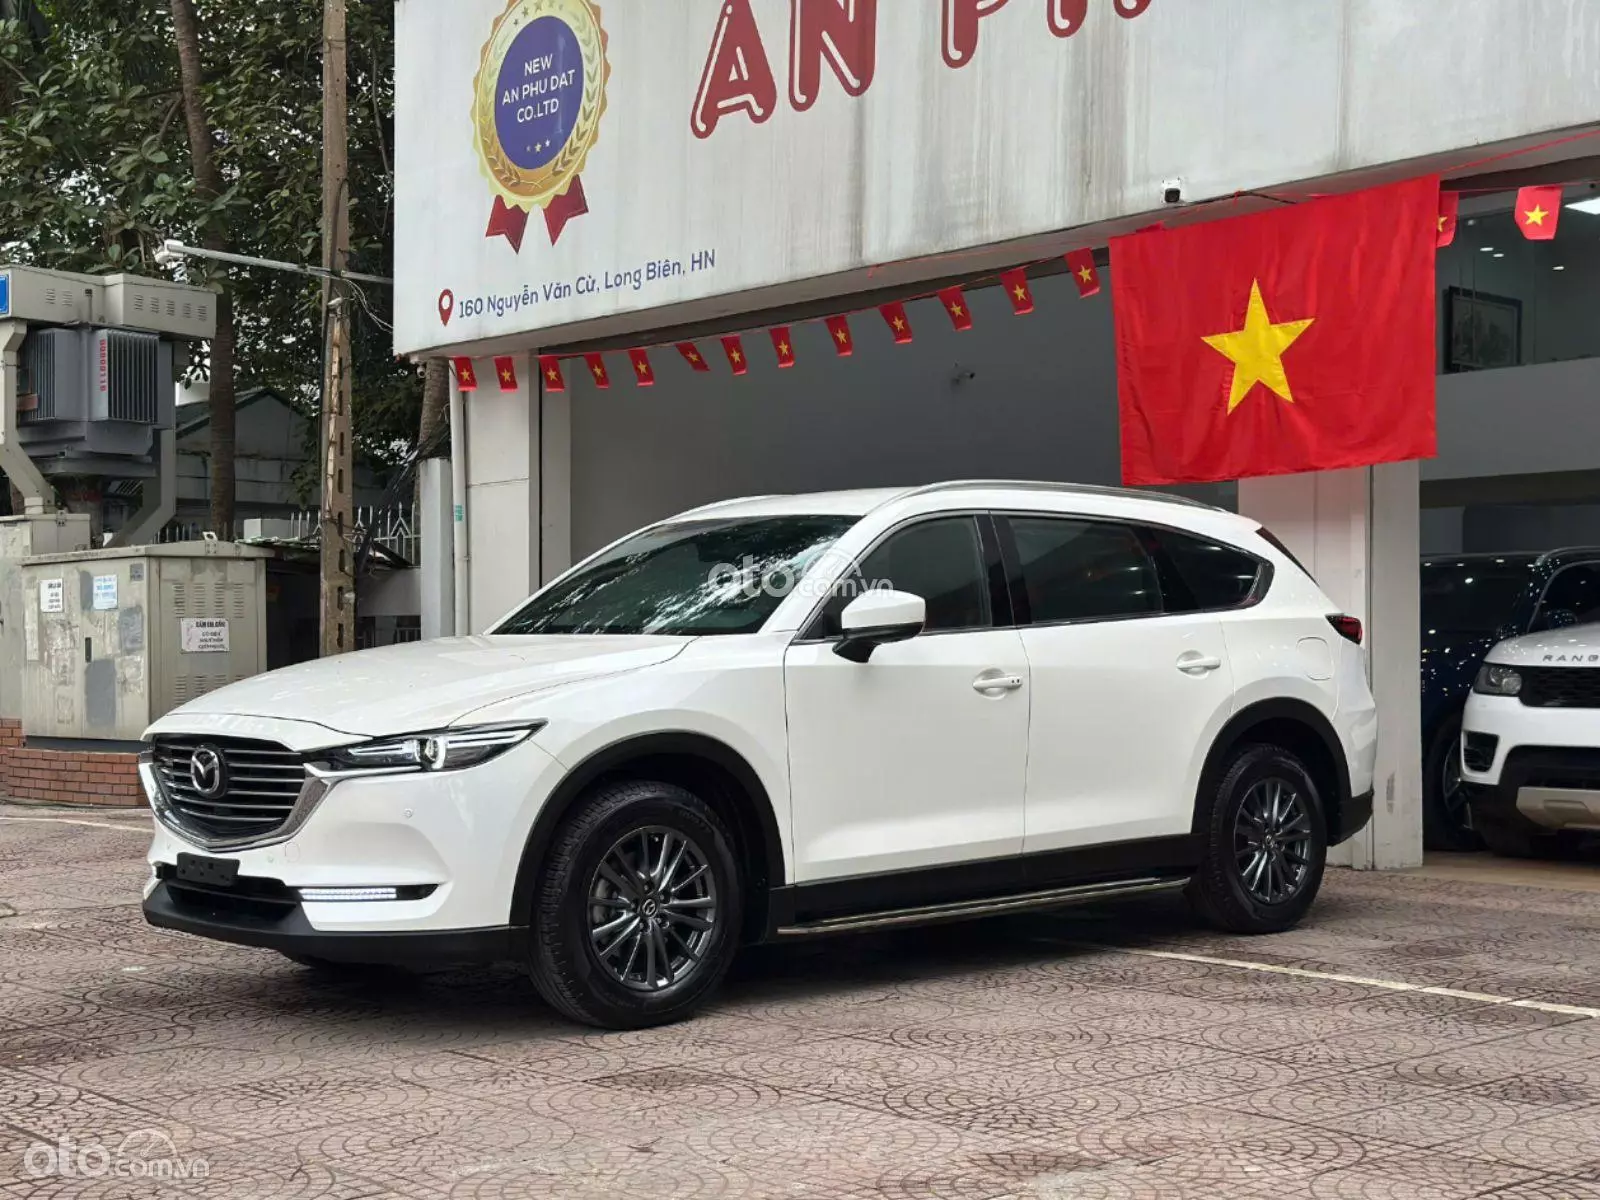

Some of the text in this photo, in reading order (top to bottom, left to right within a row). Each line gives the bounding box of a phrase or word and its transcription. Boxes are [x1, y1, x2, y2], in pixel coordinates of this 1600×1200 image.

[524, 53, 553, 76] NEW
[690, 0, 877, 139] AN
[502, 69, 576, 106] AN PHU DAT
[516, 98, 559, 123] CO.LTD
[459, 249, 715, 319] 160 Nguyễn Văn Cừ, Long Biên, HN
